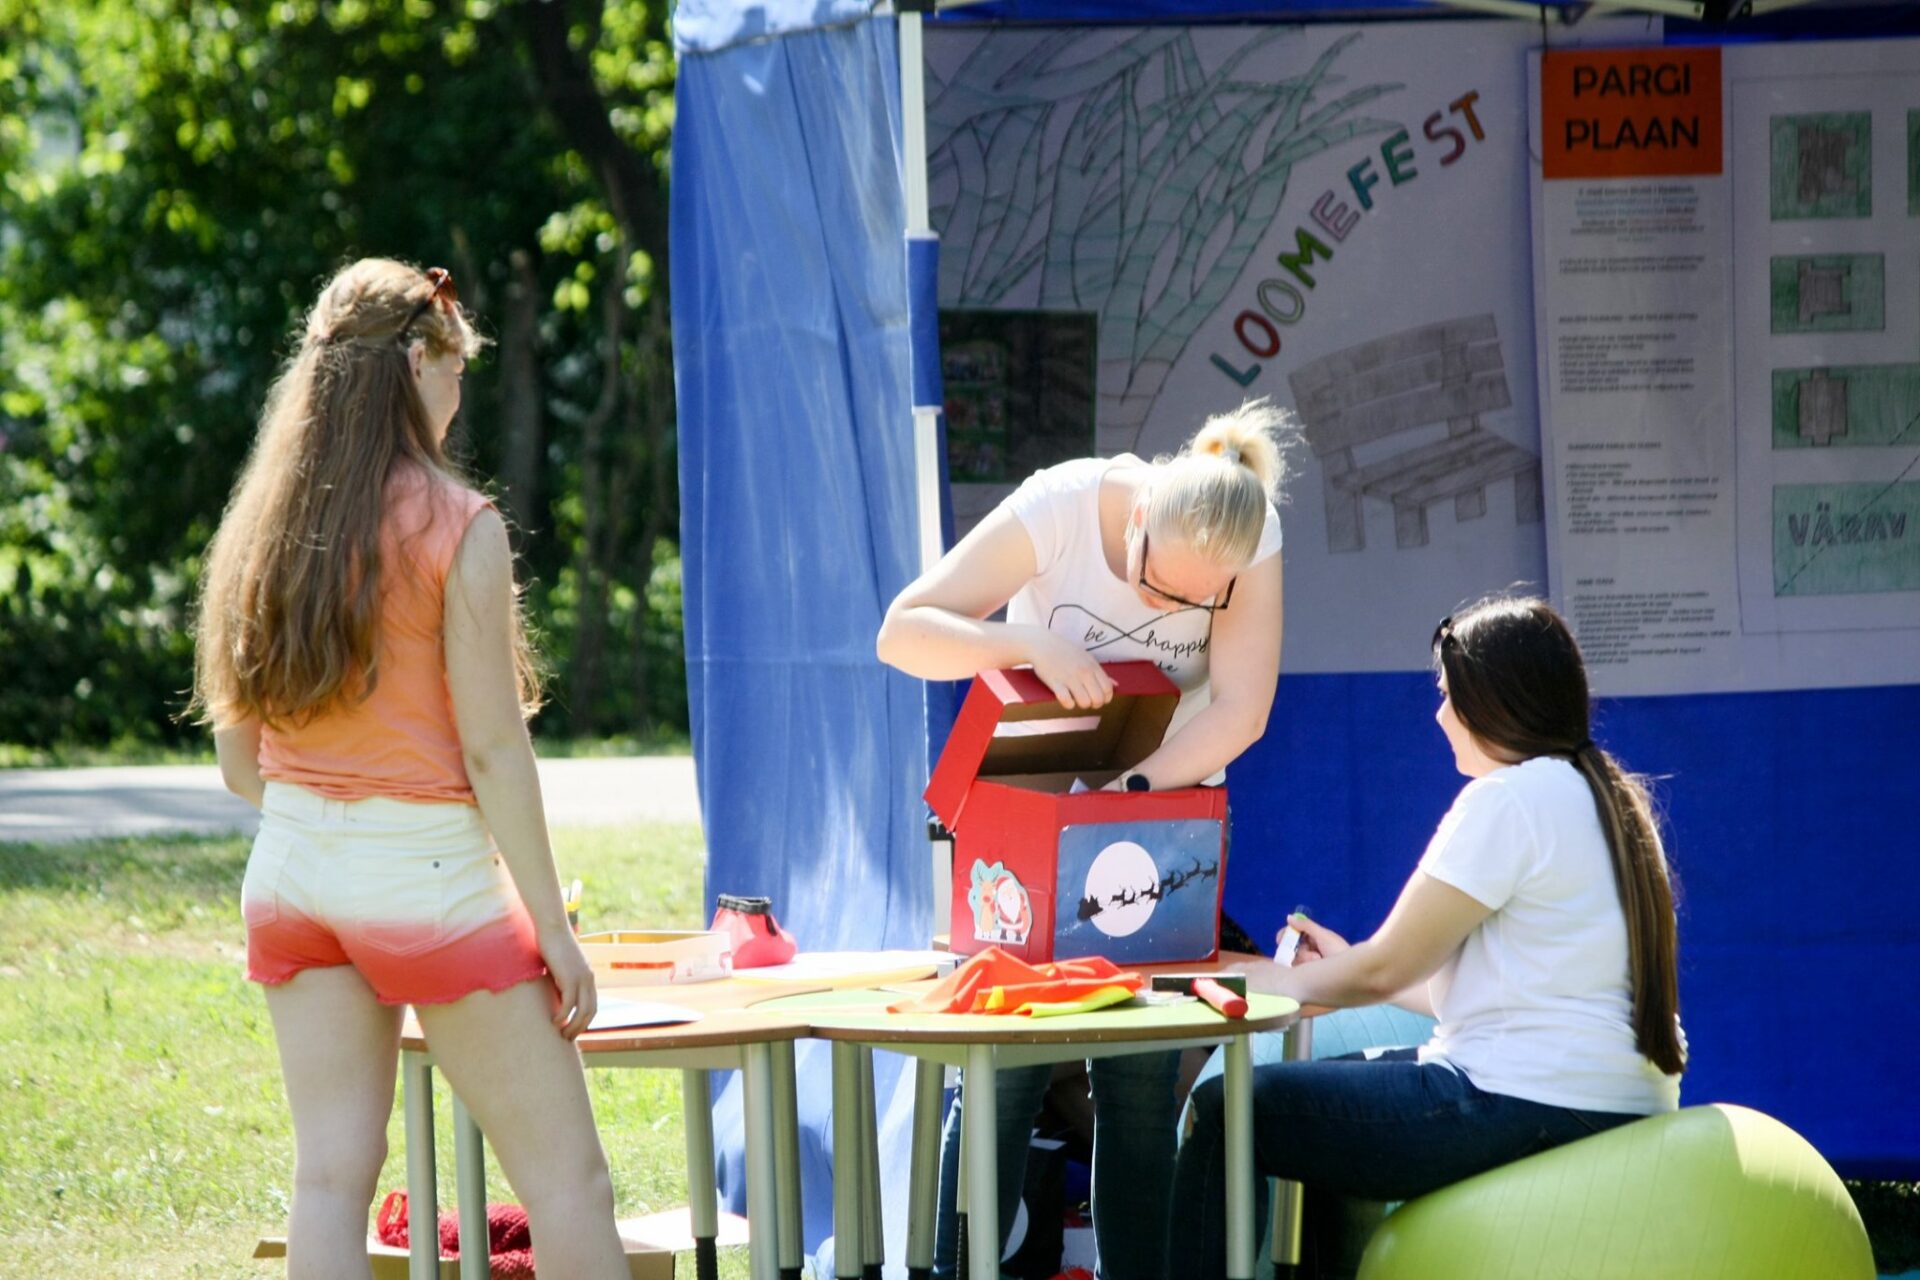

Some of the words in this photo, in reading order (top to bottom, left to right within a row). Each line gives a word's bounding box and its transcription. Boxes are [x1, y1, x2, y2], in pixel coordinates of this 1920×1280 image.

[1572, 62, 1691, 98] PARGI
[1564, 115, 1700, 151] PLAAN
[1208, 89, 1486, 388] LOOMEFEST
[1084, 625, 1108, 643] be
[1146, 629, 1208, 656] happy
